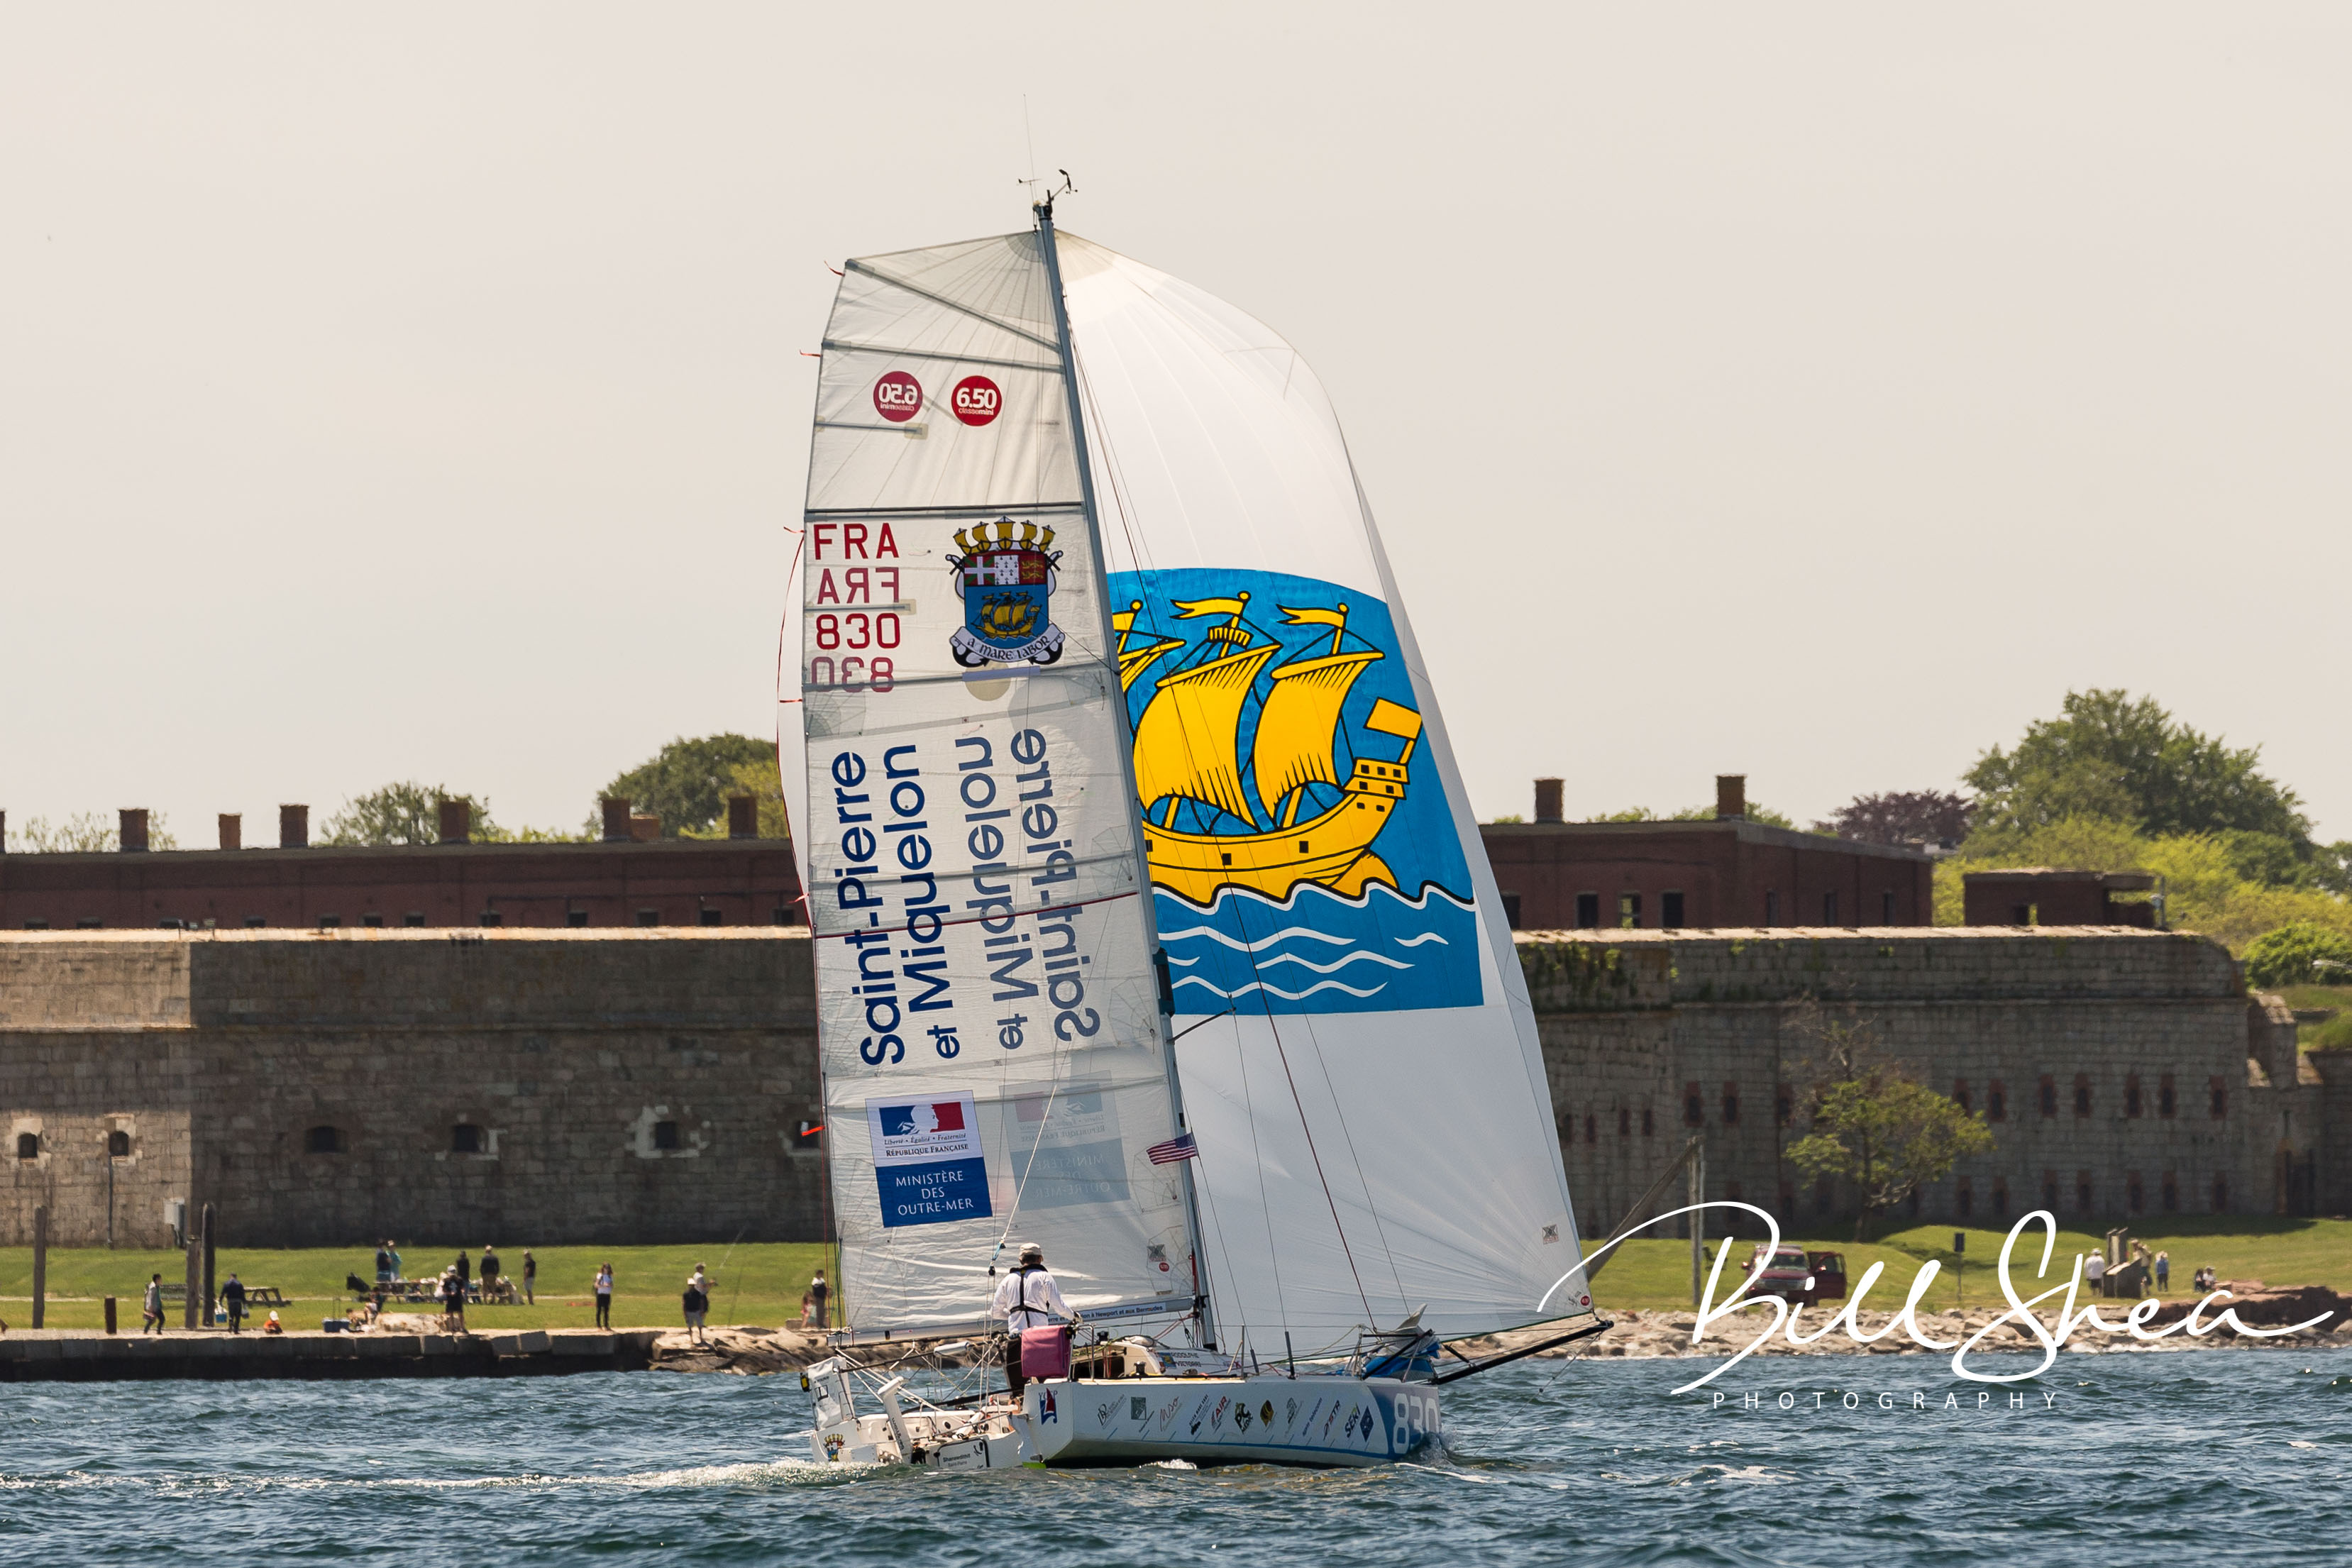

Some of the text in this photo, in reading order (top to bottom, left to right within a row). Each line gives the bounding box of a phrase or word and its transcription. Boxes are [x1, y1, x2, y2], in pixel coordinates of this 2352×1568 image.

[956, 387, 998, 409] 6.50
[812, 522, 900, 560] FRA
[815, 613, 901, 650] 830
[832, 751, 905, 1066] Saint-Pierre
[883, 744, 961, 1059] et Miquelon
[895, 1170, 964, 1186] MINISTÈRE
[921, 1187, 945, 1200] DES
[898, 1198, 974, 1216] OUTRE-MER
[1095, 1310, 1119, 1318] Newport
